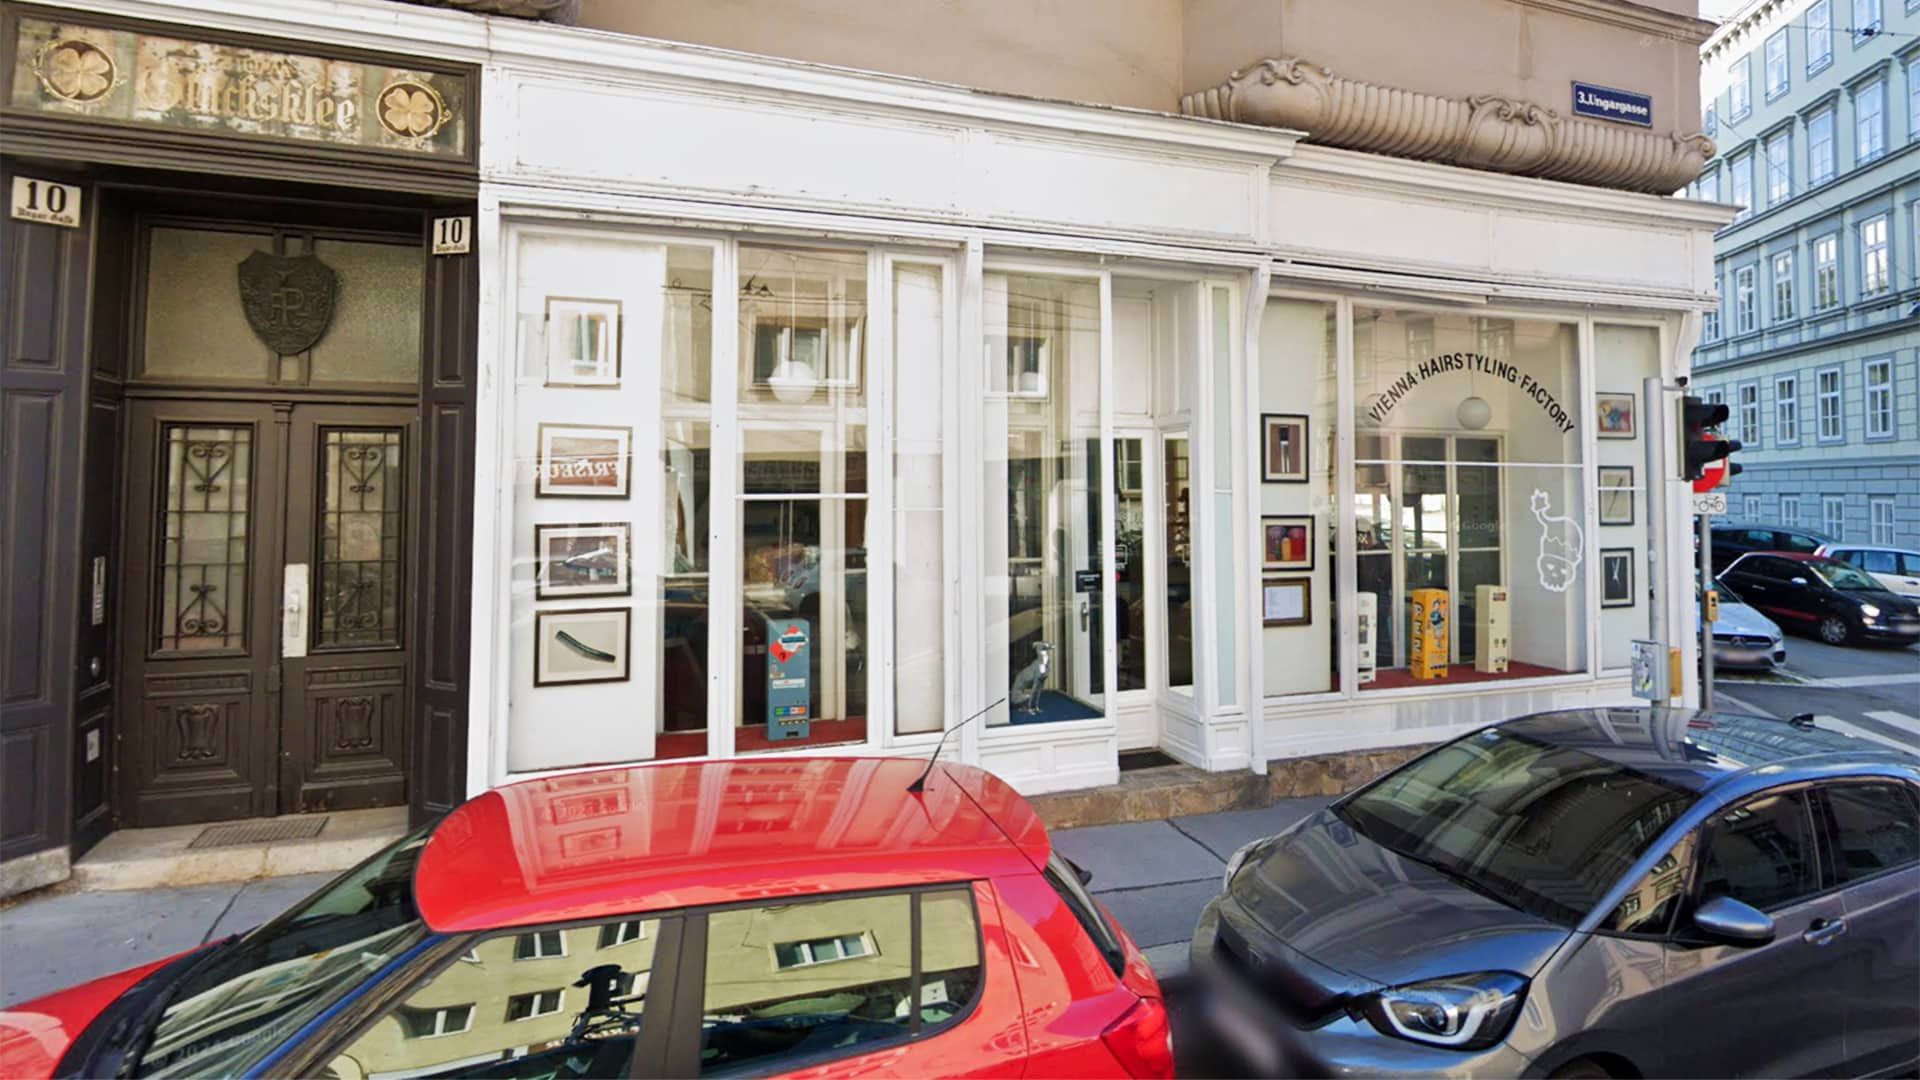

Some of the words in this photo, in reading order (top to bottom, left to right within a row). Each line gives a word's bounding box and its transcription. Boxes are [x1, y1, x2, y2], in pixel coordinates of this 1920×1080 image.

[26, 180, 67, 213] 10
[439, 218, 462, 245] 10
[1369, 372, 1418, 423] VIENNA
[1418, 352, 1518, 384] HAIRSTYLING
[1519, 374, 1575, 435] FACTORY
